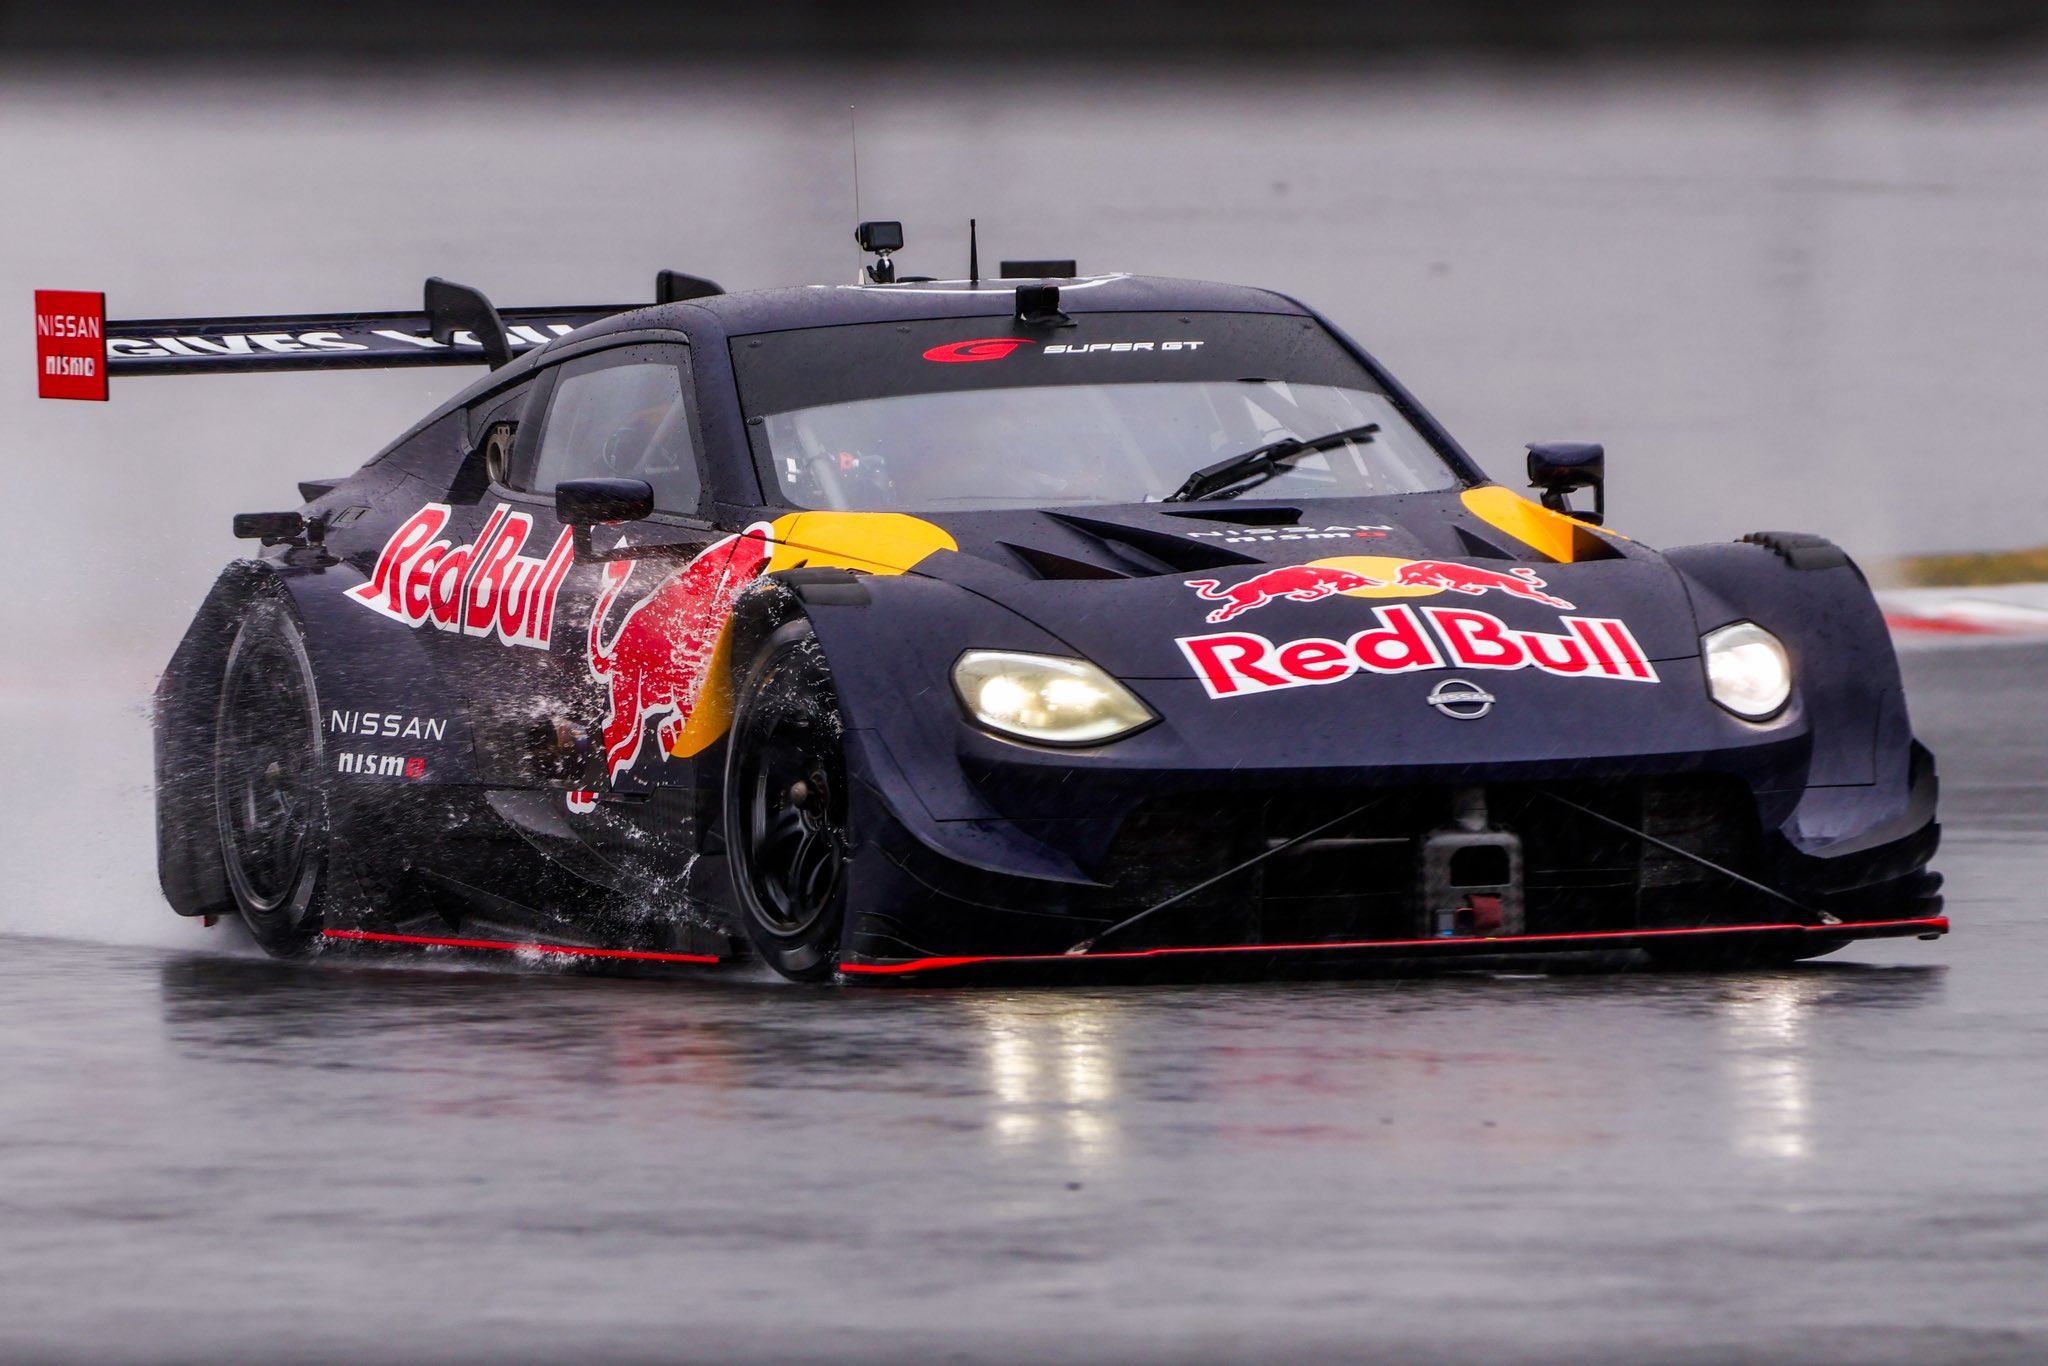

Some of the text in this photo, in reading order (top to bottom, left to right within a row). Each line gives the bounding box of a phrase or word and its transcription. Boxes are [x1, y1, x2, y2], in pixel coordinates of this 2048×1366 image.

[38, 314, 99, 338] NISSAN
[106, 332, 368, 358] GIVES
[1043, 342, 1154, 354] SUPER
[1161, 341, 1204, 350] GT
[1187, 525, 1393, 538] NISSAN
[345, 503, 574, 648] Red Bull
[1179, 606, 1657, 697] Red Bull
[331, 710, 447, 741] NISSAN
